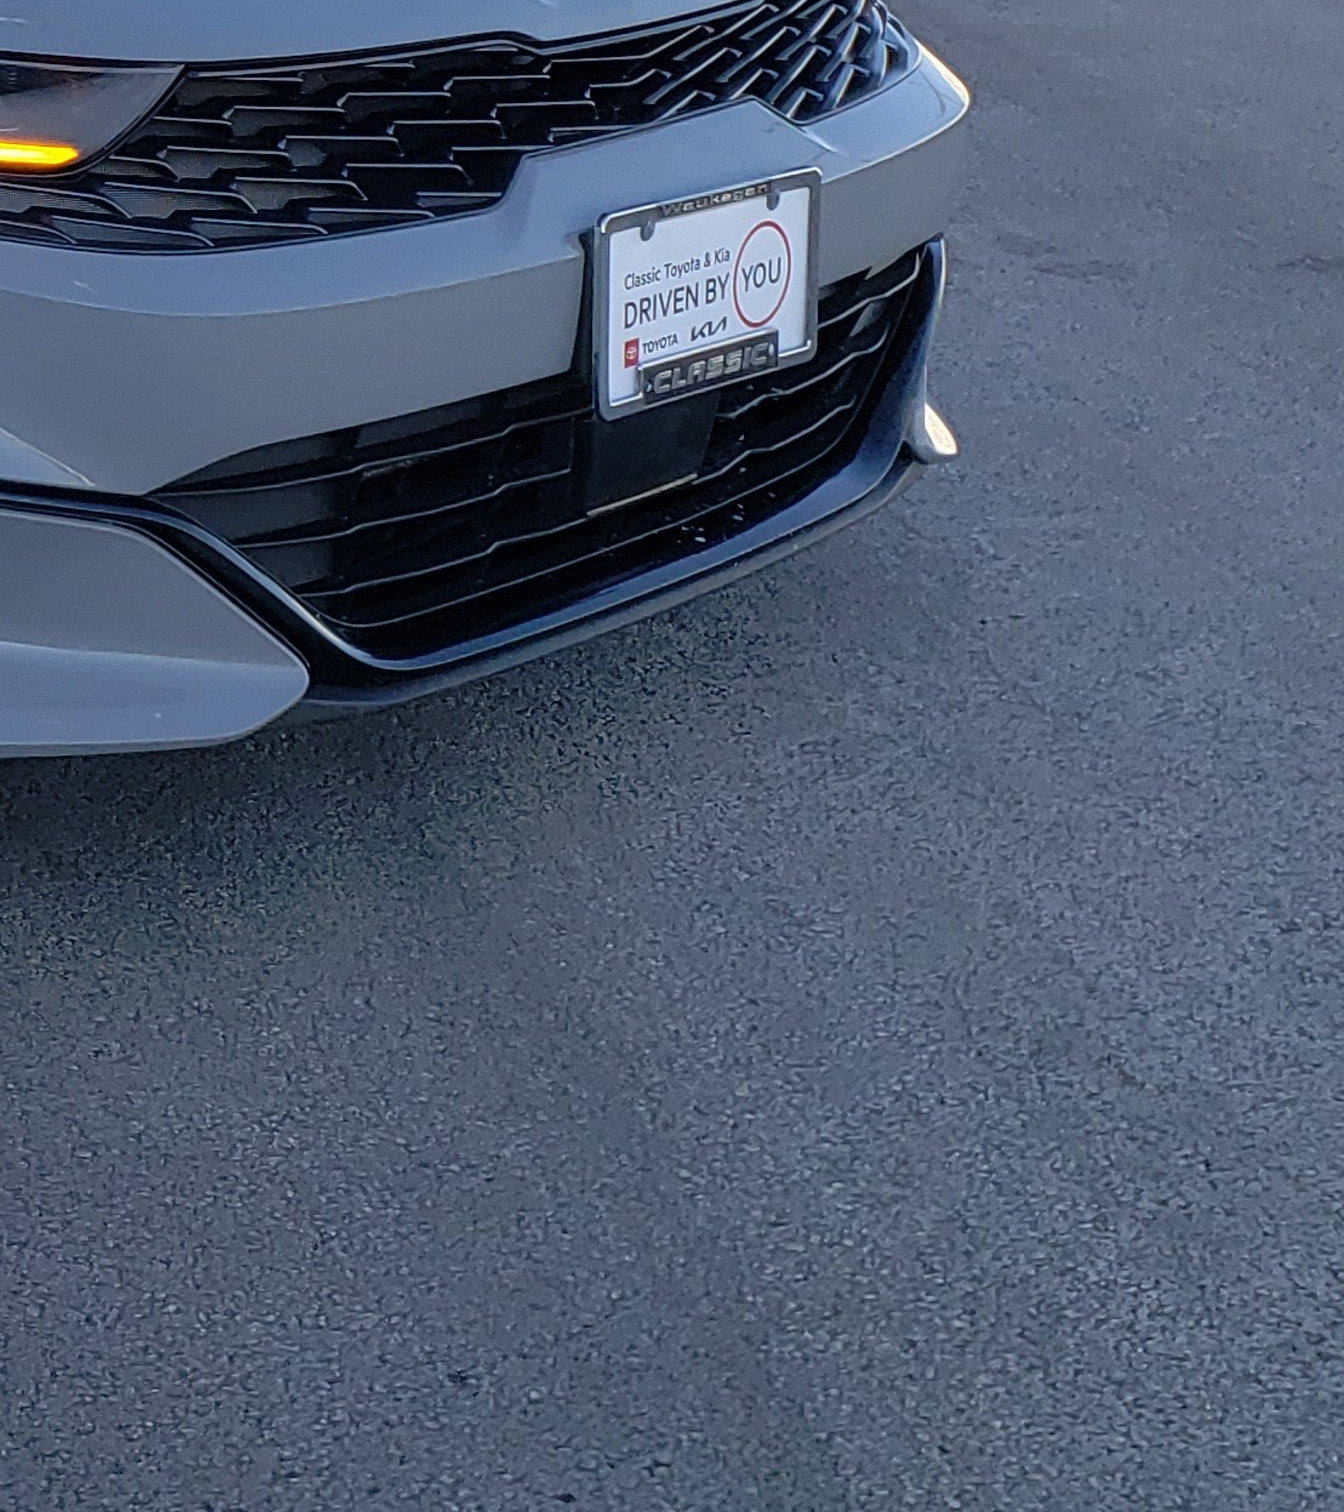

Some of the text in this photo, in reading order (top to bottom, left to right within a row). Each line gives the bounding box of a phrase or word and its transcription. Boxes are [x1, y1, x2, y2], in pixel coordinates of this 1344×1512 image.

[624, 247, 731, 290] Classic Toyota & Kia
[624, 256, 782, 329] DRIVEN BY YOU
[642, 333, 678, 355] TOYOTA
[654, 342, 769, 395] CLASSIC
